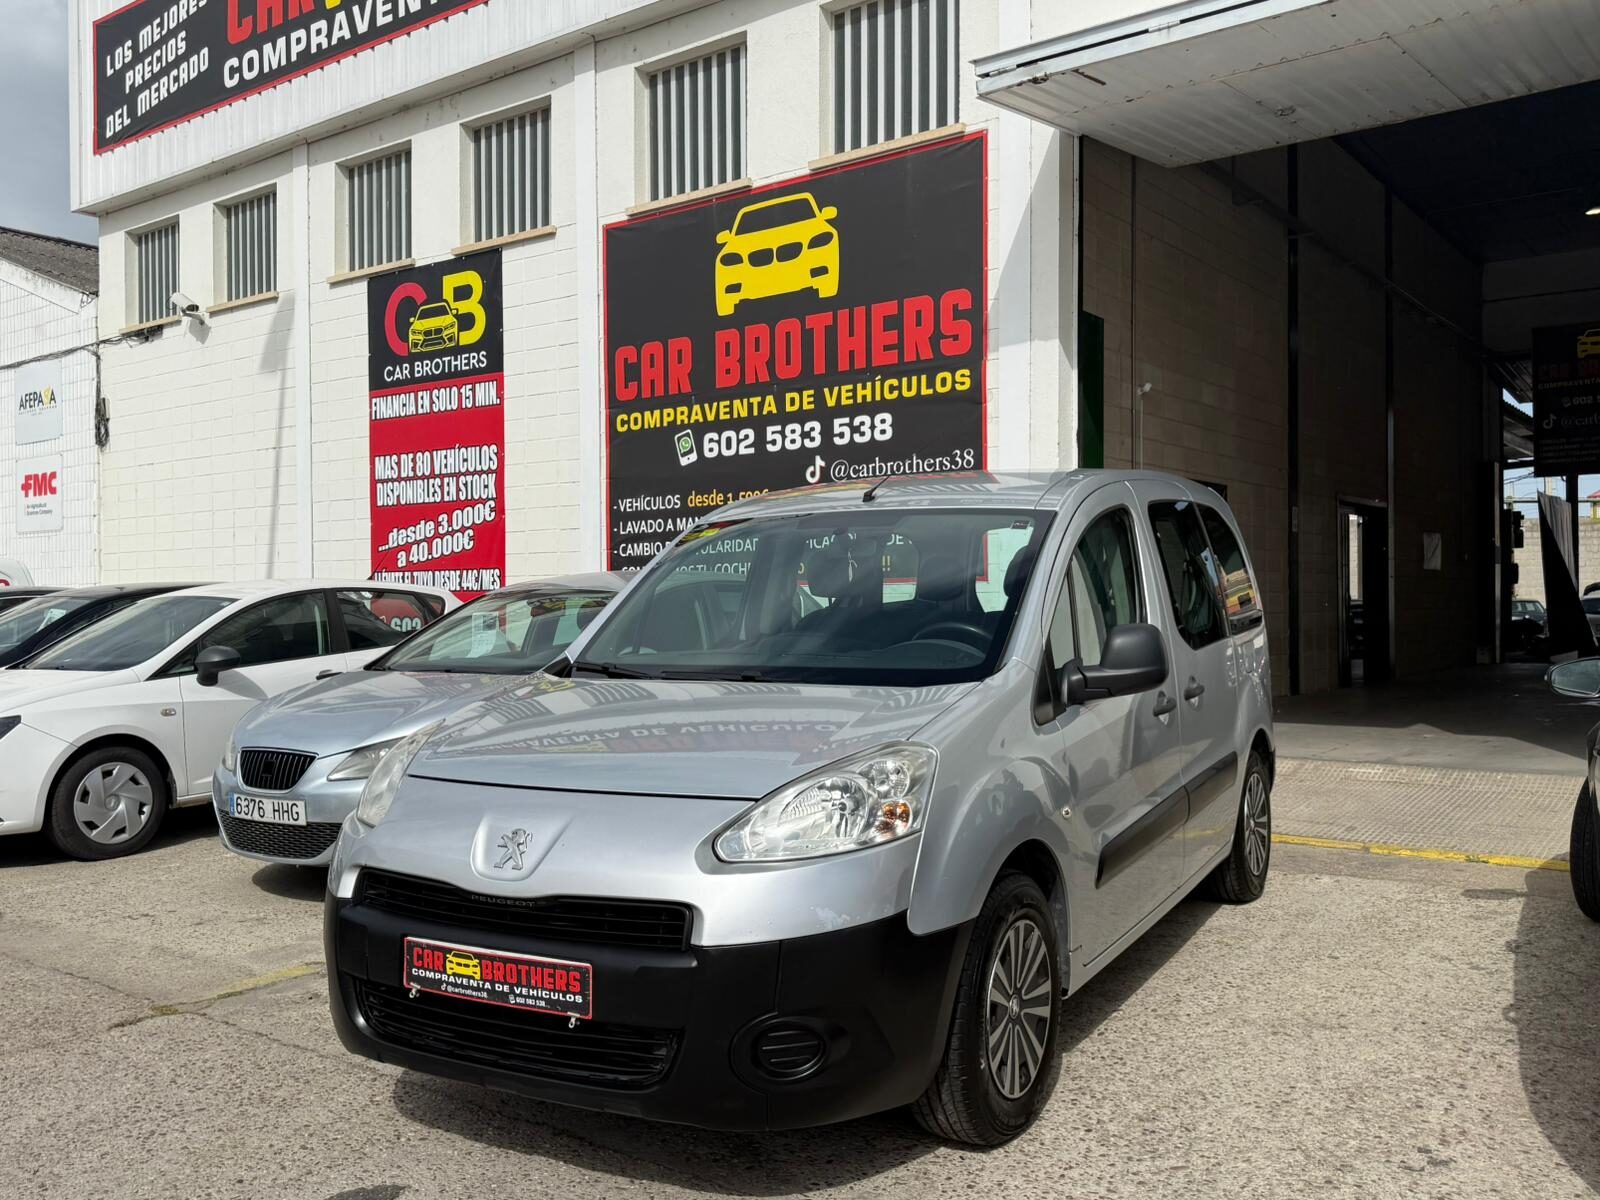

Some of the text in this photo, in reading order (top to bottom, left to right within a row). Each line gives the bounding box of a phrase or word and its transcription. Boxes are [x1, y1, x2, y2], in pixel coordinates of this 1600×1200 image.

[106, 40, 133, 77] LOS
[125, 30, 187, 95] PRECIOS
[223, 0, 437, 89] COMPRAVEN
[106, 47, 209, 139] DEL MERCADO
[614, 288, 973, 401] CAR BROTHERS
[384, 351, 487, 382] CAR BROTHERS
[371, 380, 500, 420] FINANCIA EN SOLO 15 MIN.
[616, 368, 972, 433] COMPRAVENTA DE VEHÍCULOS
[702, 412, 894, 459] 602 583 538
[375, 444, 498, 481] MAS DE 80 VEHÍCULOS
[830, 448, 975, 482] @carbrothers38
[21, 471, 57, 497] FMC
[376, 473, 497, 506] DISPONIBLES EN STOCK
[618, 494, 681, 512] VEHÍCULOS
[687, 489, 724, 508] desde
[438, 500, 496, 534] 3.000€
[620, 518, 665, 535] LAVADO
[666, 518, 674, 532] A
[397, 529, 474, 568] a 40.000€
[619, 541, 663, 557] CAMBIO
[235, 795, 300, 822] 6376 HHG
[471, 894, 537, 909] PEUGEOT
[412, 947, 582, 993] CAR BROTHERS
[412, 968, 583, 1003] COMPRAVENTA DE VEHÍCULOS
